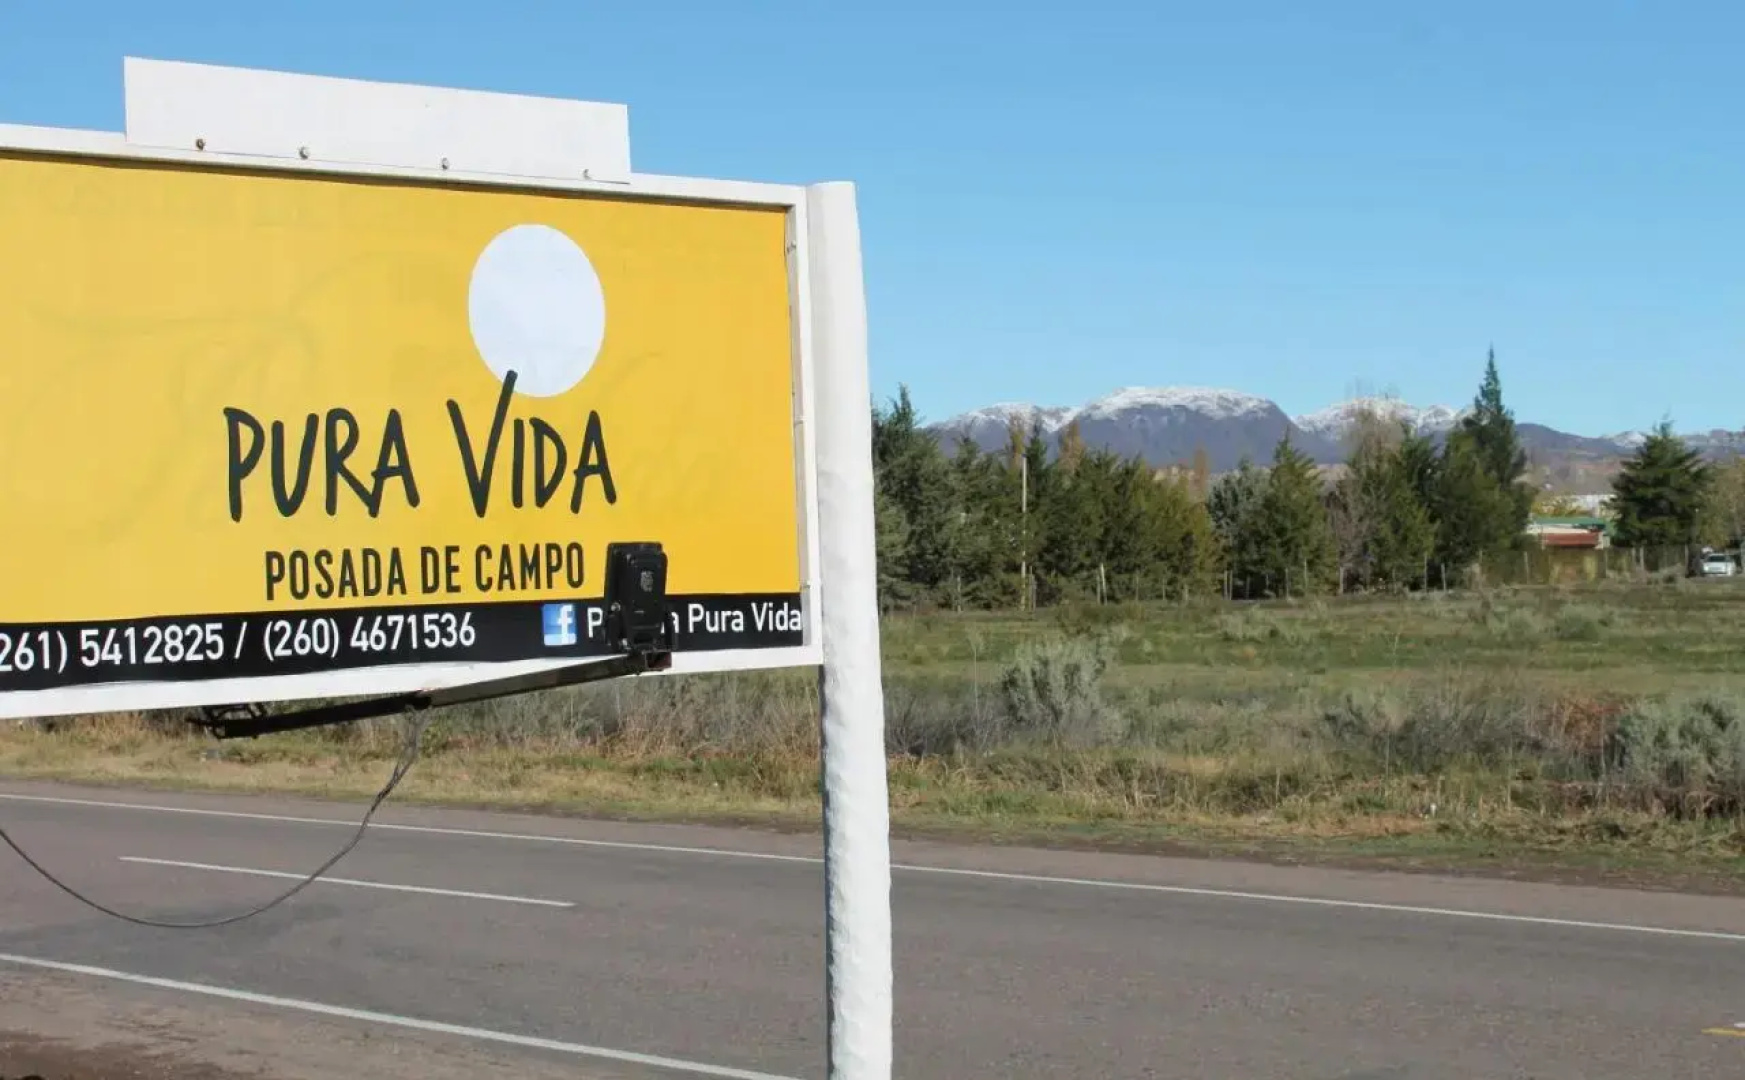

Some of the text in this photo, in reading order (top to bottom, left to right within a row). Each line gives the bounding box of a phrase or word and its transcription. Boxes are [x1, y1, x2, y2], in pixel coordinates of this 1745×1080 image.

[222, 369, 617, 523] PURA VIDA
[264, 542, 584, 601] POSADA DE CAMPO
[80, 623, 224, 667] 5412825
[264, 618, 339, 662] (260)
[350, 612, 476, 652] 4671536
[687, 603, 744, 634] Pura
[751, 602, 802, 632] Vida
